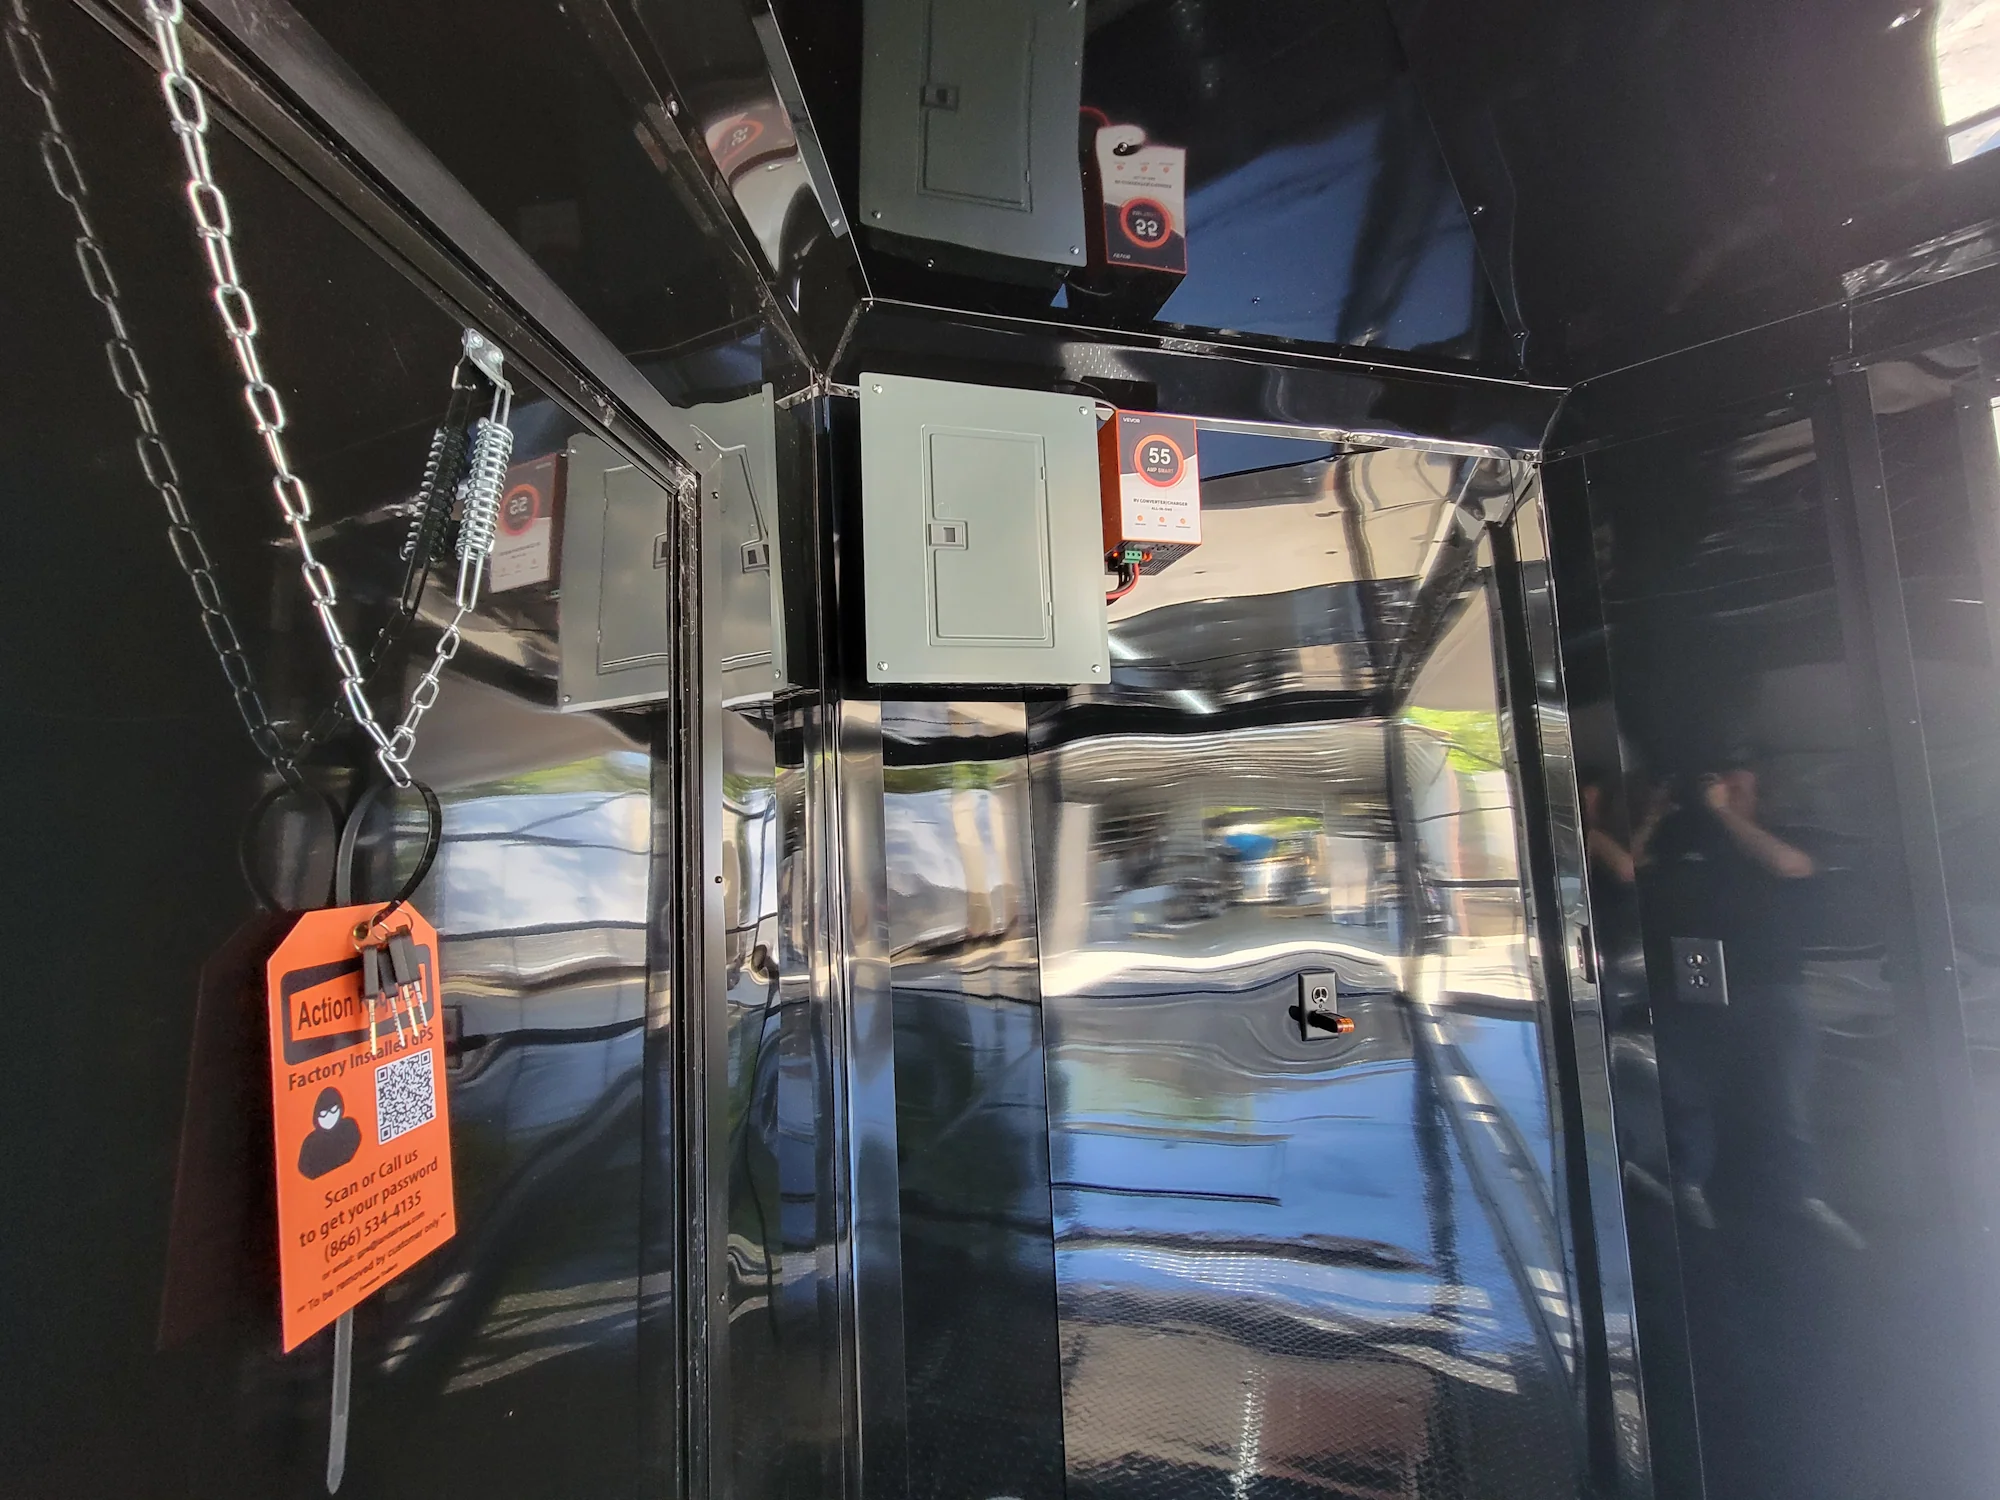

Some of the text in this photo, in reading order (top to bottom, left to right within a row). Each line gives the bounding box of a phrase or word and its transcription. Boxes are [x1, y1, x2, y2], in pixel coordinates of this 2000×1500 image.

[1149, 447, 1171, 465] 55
[298, 996, 353, 1031] Action
[288, 1059, 347, 1092] Factory
[299, 1228, 316, 1248] to
[320, 1210, 345, 1241] get
[348, 1192, 379, 1224] your
[382, 1155, 439, 1205] password
[324, 1149, 419, 1209] Scan or Call us
[324, 1226, 361, 1264] (866)
[364, 1190, 422, 1238] 534-4135
[308, 1297, 320, 1311] To
[322, 1289, 334, 1302] be
[336, 1259, 374, 1293] removed
[376, 1253, 386, 1267] by
[388, 1229, 424, 1258] customer
[425, 1218, 440, 1234] only
